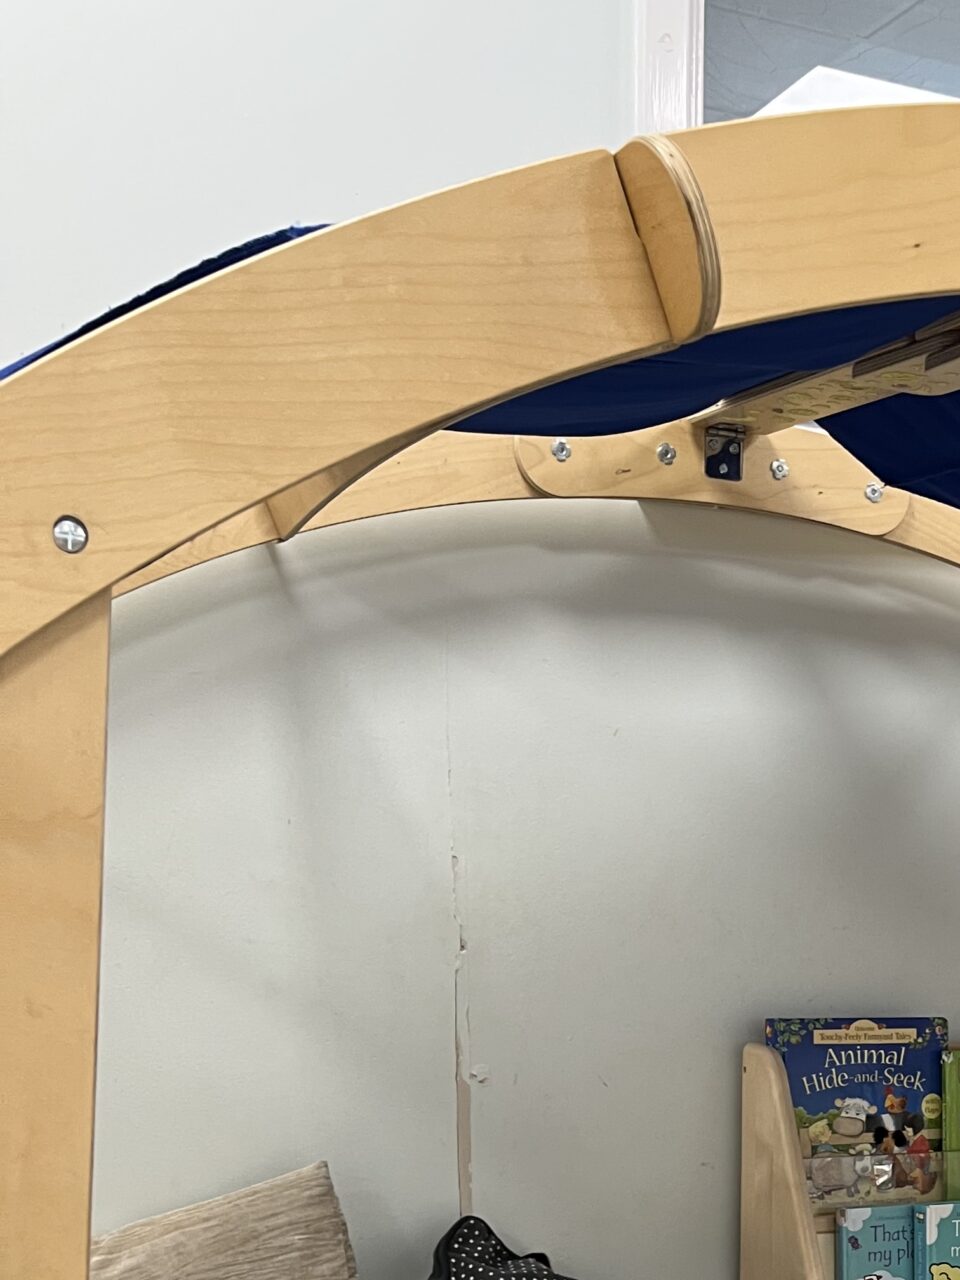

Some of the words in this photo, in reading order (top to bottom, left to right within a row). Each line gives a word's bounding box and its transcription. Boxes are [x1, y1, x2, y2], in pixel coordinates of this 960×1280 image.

[824, 1046, 905, 1068] Animal
[801, 1067, 927, 1095] Hide-and-Seek
[868, 1249, 892, 1268] my
